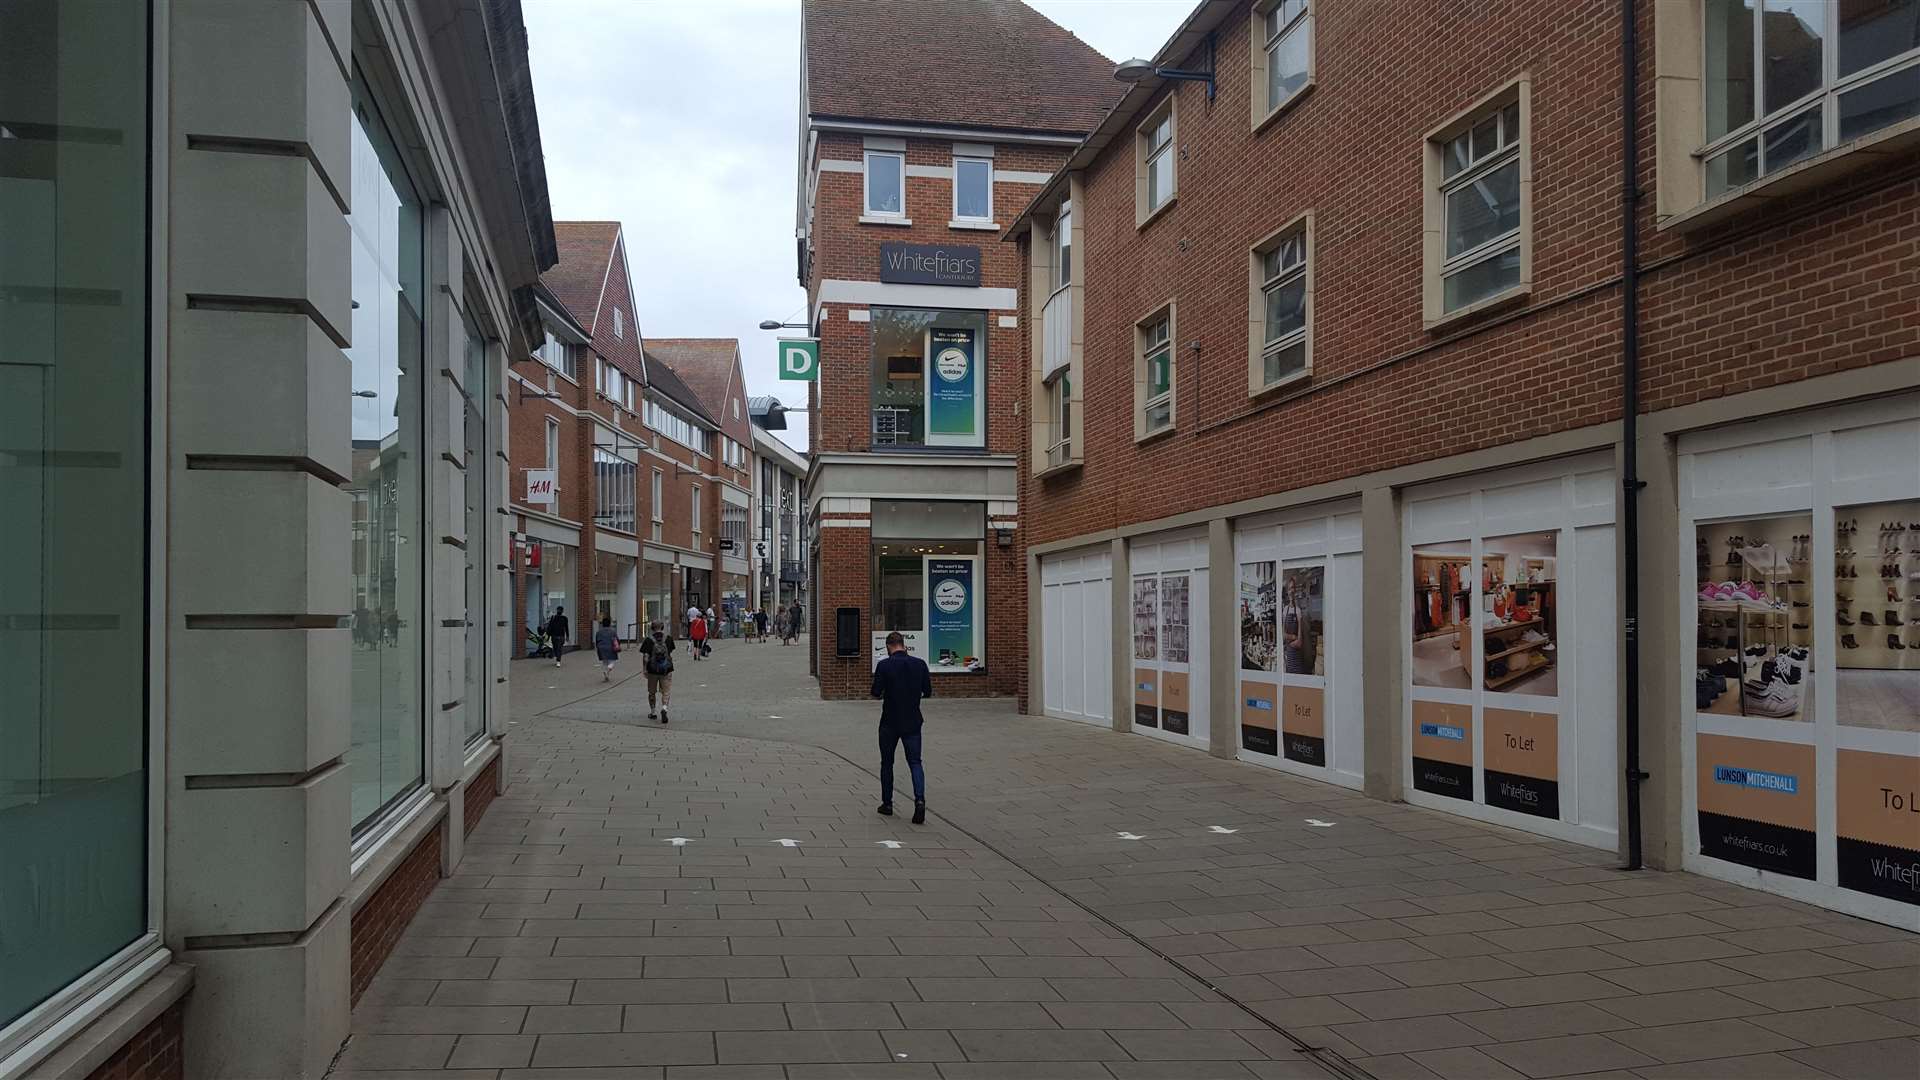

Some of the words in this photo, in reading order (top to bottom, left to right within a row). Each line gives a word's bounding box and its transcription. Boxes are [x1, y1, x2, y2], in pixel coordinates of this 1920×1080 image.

[887, 248, 976, 279] Whitefriars
[786, 348, 812, 374] D
[529, 480, 551, 494] H&M
[1505, 734, 1517, 749] To
[1520, 736, 1535, 751] Let
[1716, 767, 1795, 792] LUNSONMITCHENALL
[1880, 788, 1904, 810] To
[1722, 832, 1789, 857] whitefriars.co.uk
